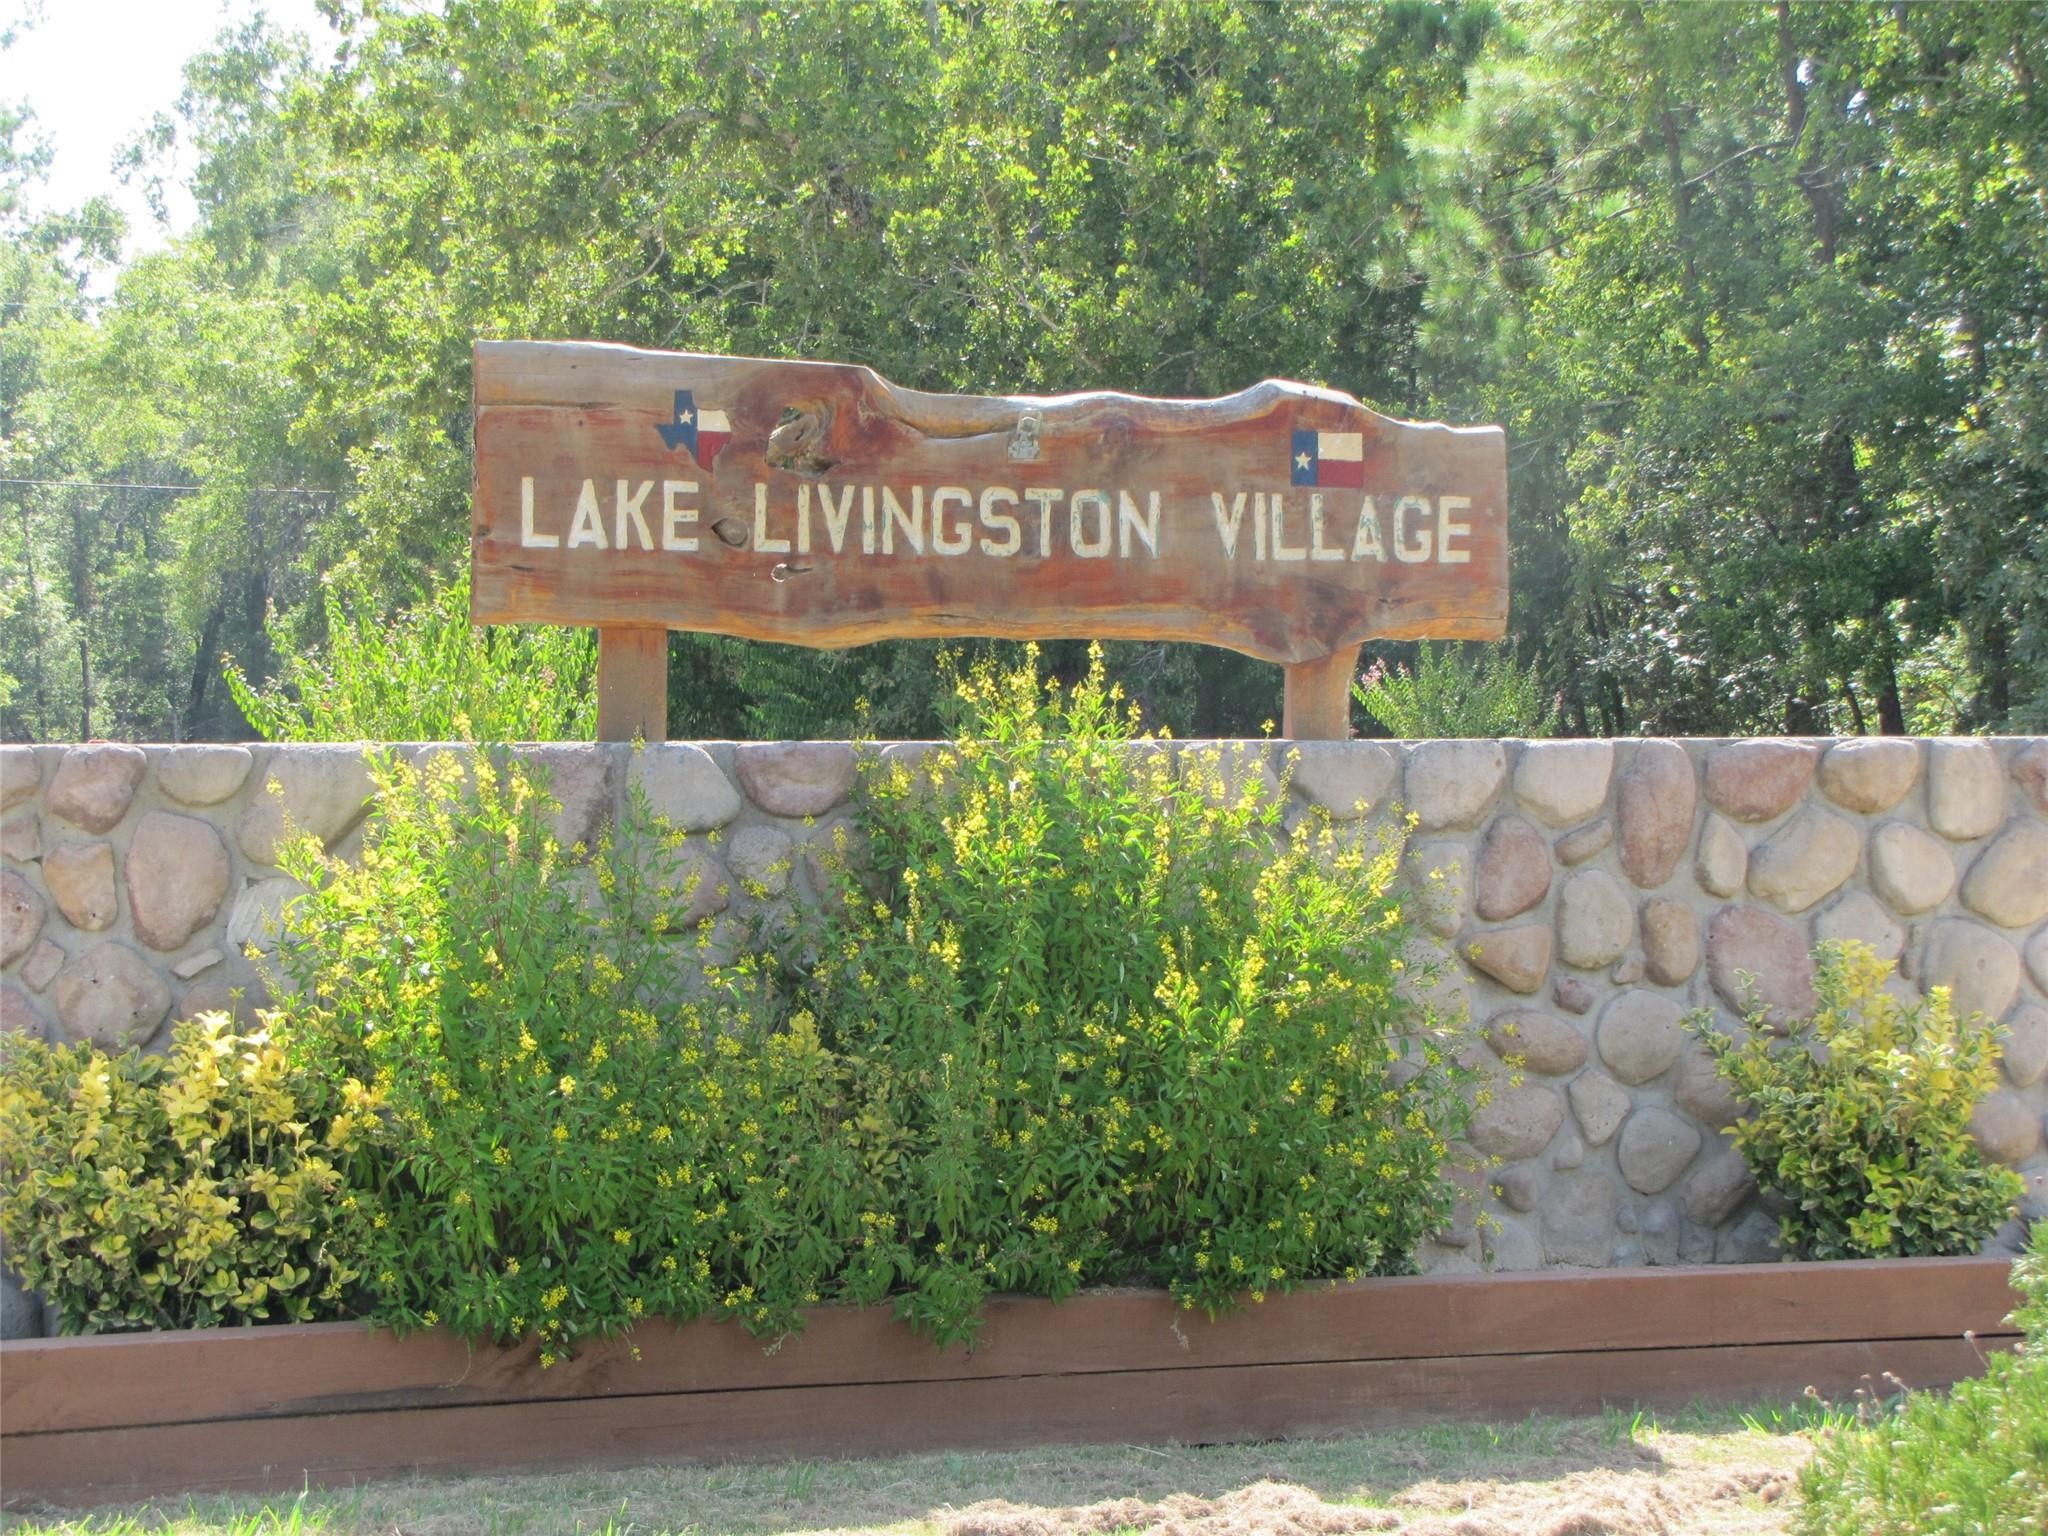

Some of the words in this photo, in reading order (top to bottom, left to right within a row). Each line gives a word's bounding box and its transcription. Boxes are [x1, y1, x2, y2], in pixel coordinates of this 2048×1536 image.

[520, 476, 700, 552] LAKE
[753, 482, 1161, 559] LIVINGSTON
[1210, 490, 1472, 564] VILLAGE
